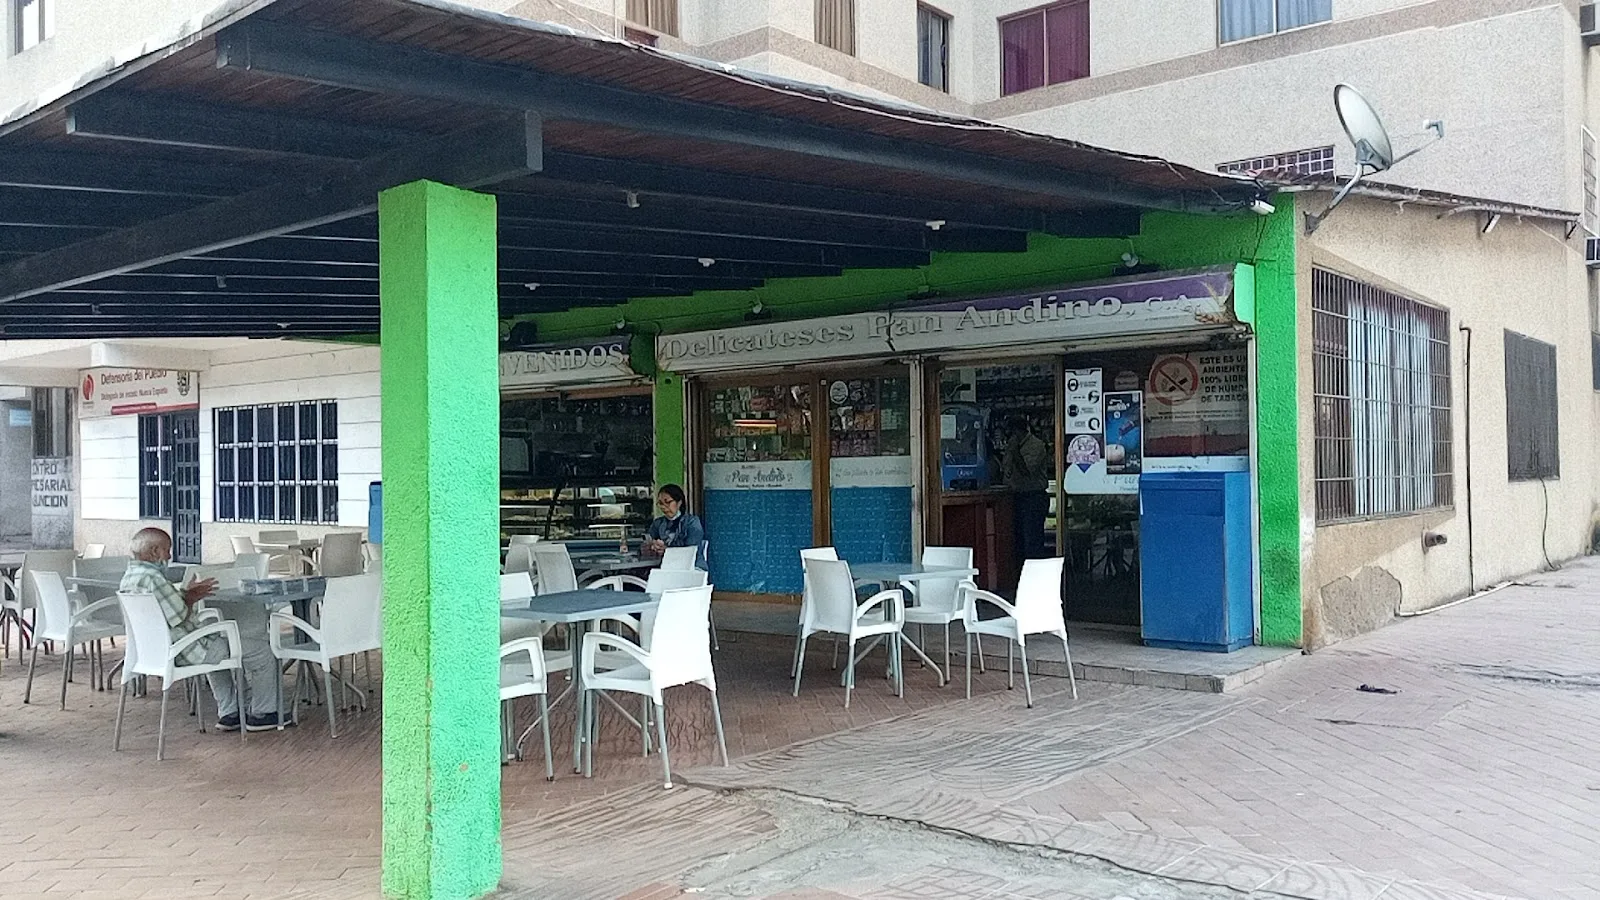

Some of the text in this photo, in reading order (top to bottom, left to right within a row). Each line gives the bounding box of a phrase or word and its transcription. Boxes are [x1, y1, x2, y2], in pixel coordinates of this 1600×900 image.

[664, 321, 854, 361] Delicateses
[867, 313, 943, 339] Pan
[1199, 356, 1220, 364] ESTE
[1223, 355, 1234, 363] ES
[1200, 375, 1222, 384] 100%
[1204, 385, 1216, 393] DE
[1201, 395, 1212, 403] DE
